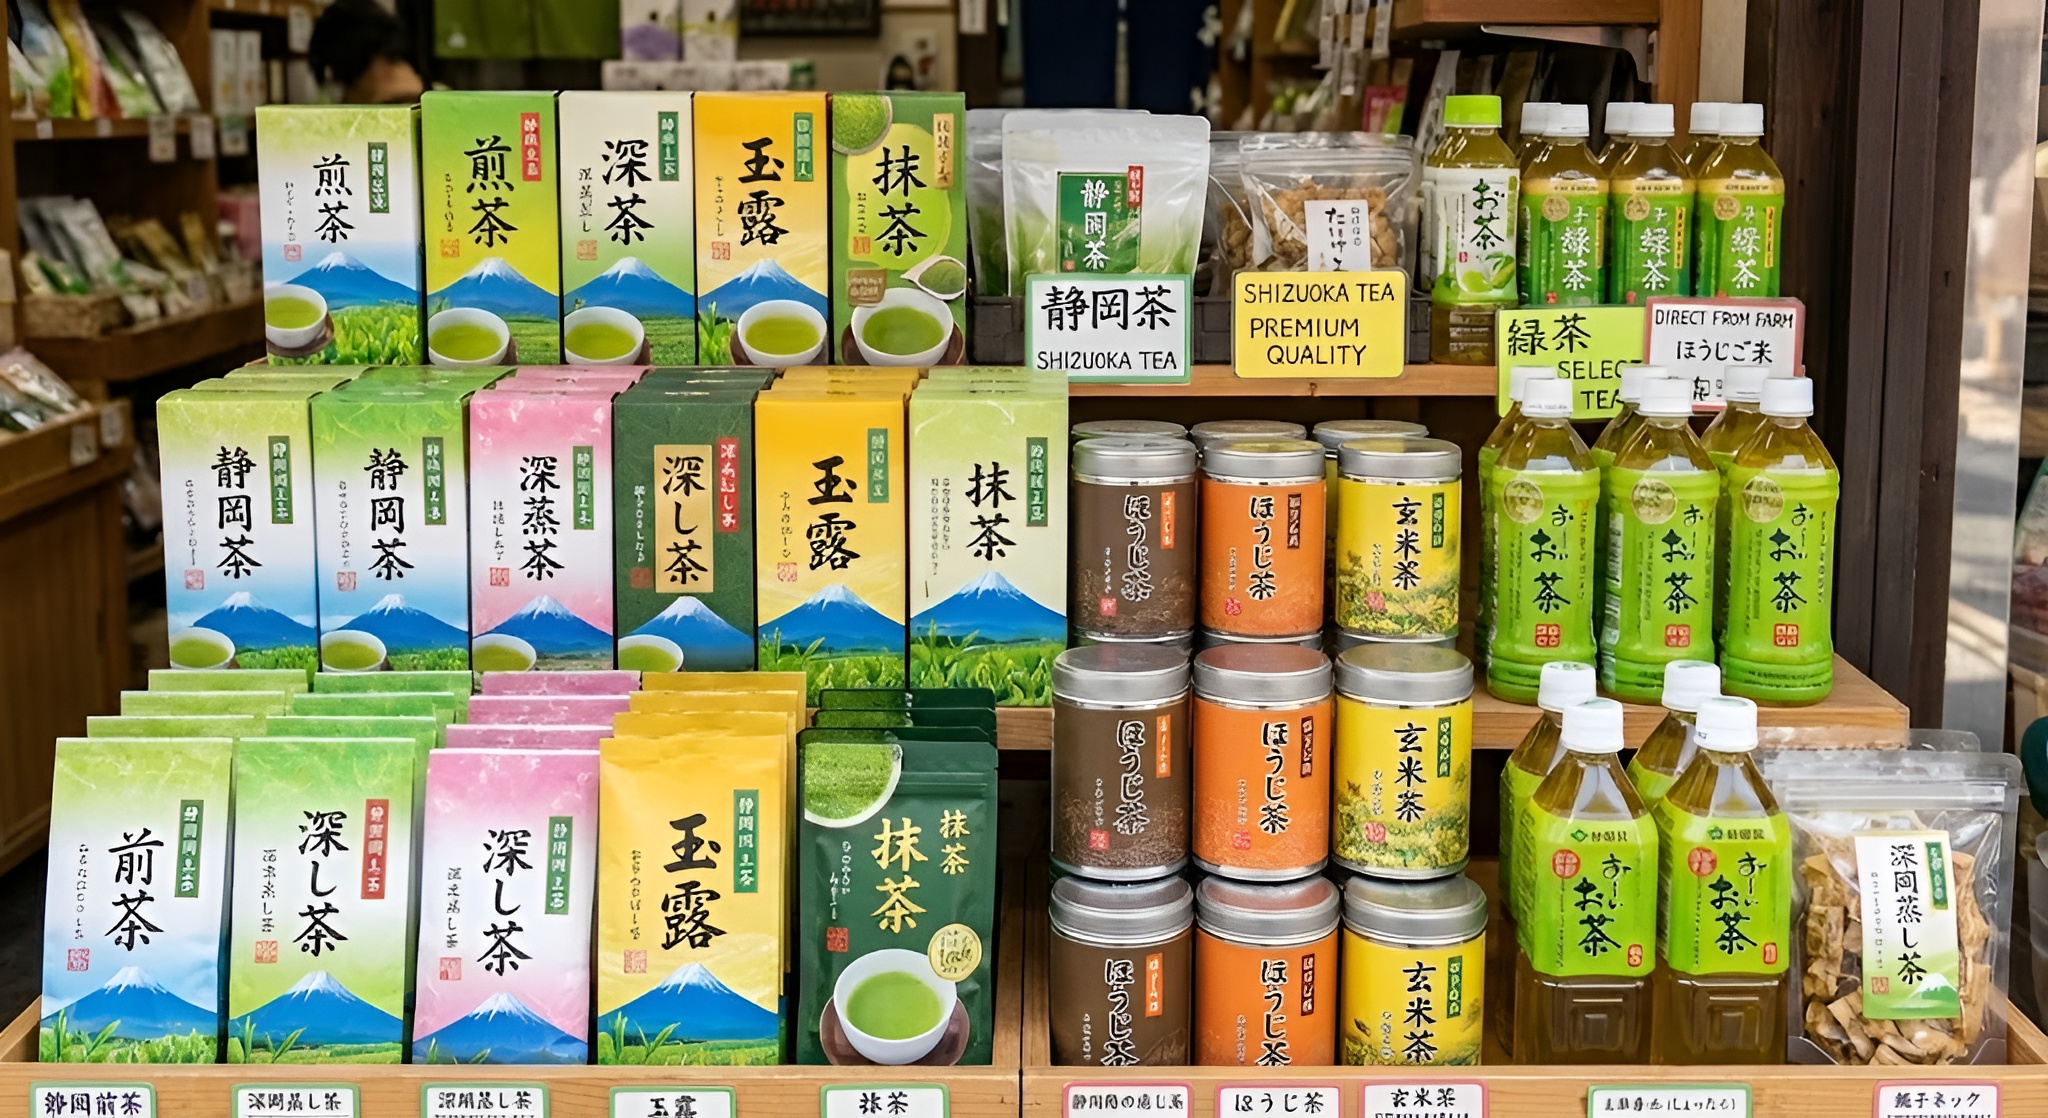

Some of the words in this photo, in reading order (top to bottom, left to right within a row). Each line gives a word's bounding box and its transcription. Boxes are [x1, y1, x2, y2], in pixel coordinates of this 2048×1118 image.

[312, 153, 356, 245] 煎茶
[463, 134, 519, 248] 煎茶
[600, 138, 655, 246] 深茶
[737, 137, 789, 247] 玉露
[872, 144, 928, 257] 抹茶
[1470, 178, 1505, 250] お茶
[1041, 284, 1177, 332] 静岡茶
[1244, 284, 1349, 303] SHIZUOKA
[1356, 283, 1395, 302] TEA
[1250, 318, 1359, 338] PREMIUM
[1508, 313, 1591, 356] 緑茶
[1655, 309, 1707, 326] DIRECT
[1713, 311, 1750, 326] FROM
[1756, 312, 1794, 329] FARM
[1138, 351, 1177, 370] TEA
[1267, 345, 1367, 366] QUALITY
[1558, 360, 1642, 380] SELEC
[211, 446, 263, 580] 静岡茶
[363, 447, 415, 581] 静岡茶
[519, 455, 565, 581] 深蒸茶
[662, 455, 709, 585] 深し茶
[806, 455, 861, 571] 玉露
[965, 461, 1017, 561] 抹茶
[1247, 496, 1276, 601] ほうじ茶
[1392, 497, 1422, 591] 玄米茶
[1529, 528, 1571, 614] お茶
[1661, 528, 1698, 614] お茶
[1769, 528, 1807, 614] お茶
[1259, 721, 1293, 836] ほうじ茶
[1394, 722, 1427, 823] 玄米茶
[104, 827, 164, 952] 前茶
[292, 810, 349, 957] 深し茶
[661, 813, 727, 951] 玉露
[870, 817, 929, 934] 抹茶
[939, 809, 971, 875] 抹茶
[477, 828, 533, 976] 深し茶
[1573, 876, 1622, 957] お茶
[1708, 874, 1757, 955] お茶
[1402, 961, 1438, 1064] 玄米茶
